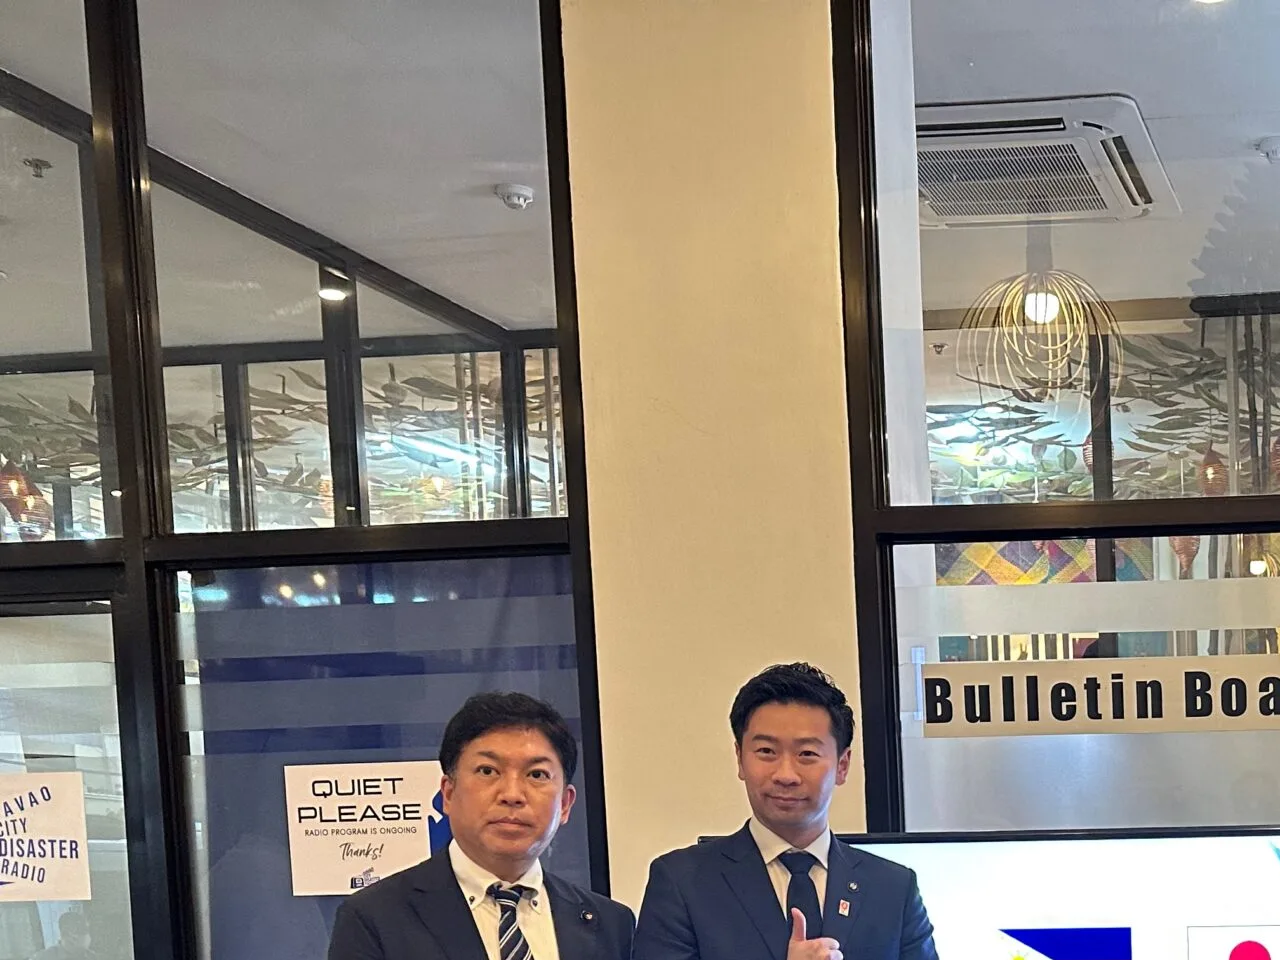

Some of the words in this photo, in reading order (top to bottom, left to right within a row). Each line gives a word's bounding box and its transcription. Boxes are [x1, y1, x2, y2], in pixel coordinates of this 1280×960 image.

[924, 673, 1163, 724] Bulletin
[312, 778, 403, 798] QUIET
[298, 804, 421, 823] PLEASE
[331, 828, 368, 836] PROGRAM
[370, 827, 377, 835] IS
[380, 826, 417, 834] ONGOING
[0, 838, 79, 859] DISASTER
[339, 842, 384, 861] Thanks!
[1, 858, 45, 883] RADIO
